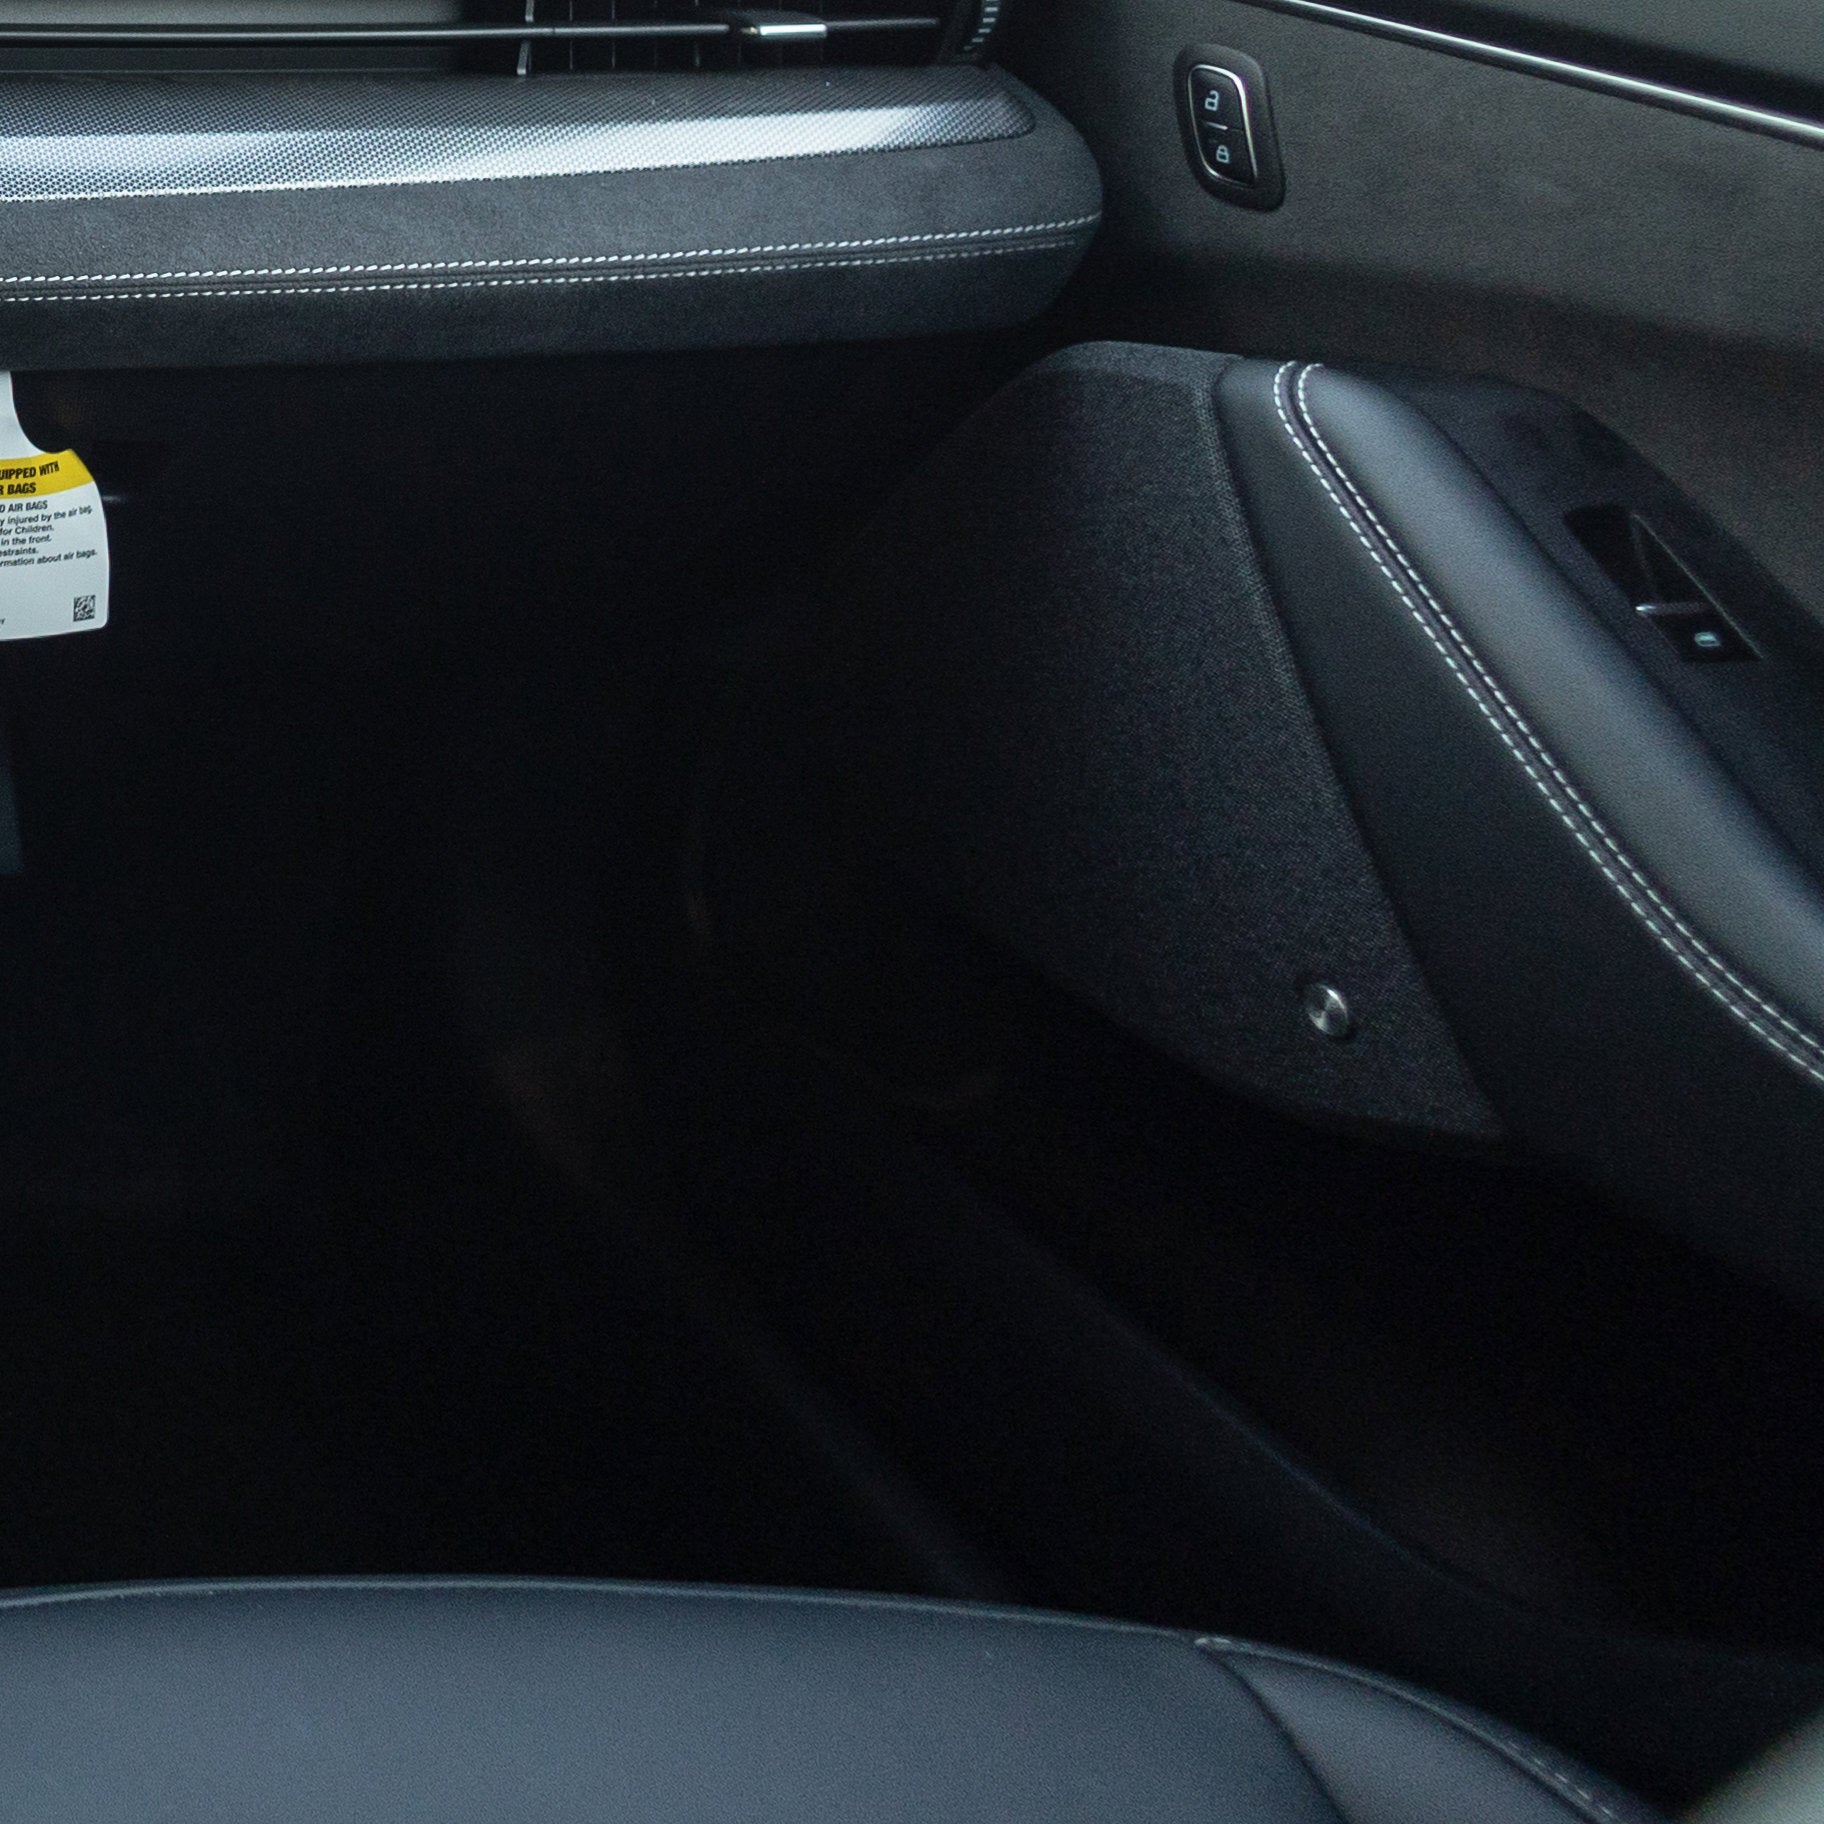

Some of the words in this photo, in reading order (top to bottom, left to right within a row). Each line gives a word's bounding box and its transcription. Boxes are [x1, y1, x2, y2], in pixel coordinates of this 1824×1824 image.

[38, 461, 60, 476] WITH
[7, 482, 36, 495] BAGS
[7, 502, 23, 513] AIR
[25, 500, 48, 511] BAGS
[7, 514, 39, 526] injured
